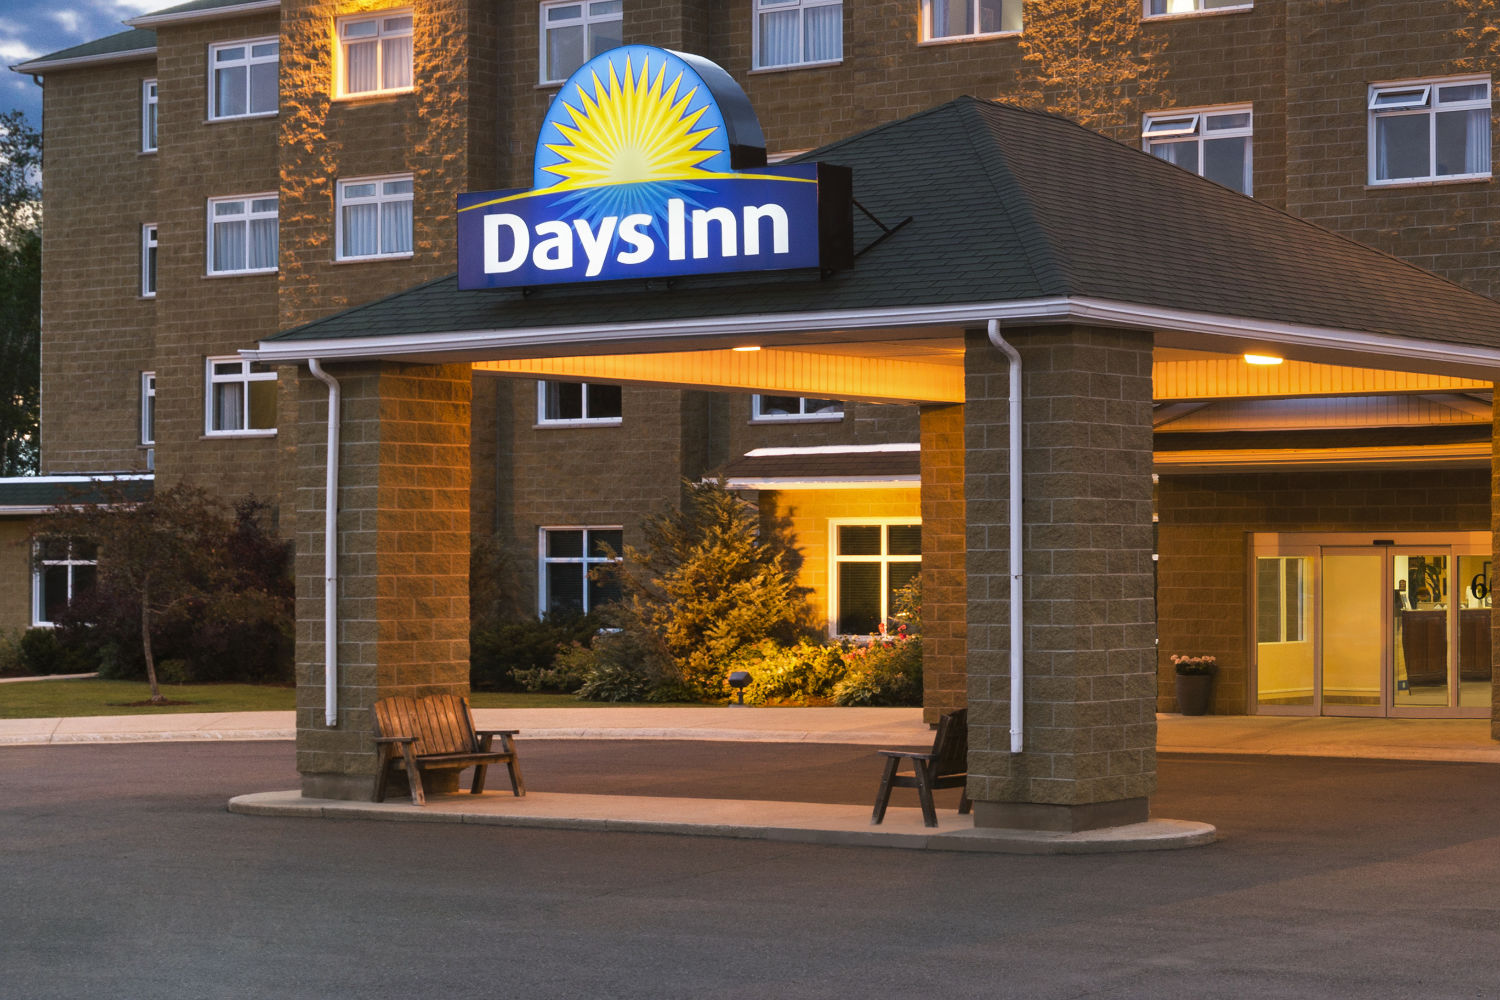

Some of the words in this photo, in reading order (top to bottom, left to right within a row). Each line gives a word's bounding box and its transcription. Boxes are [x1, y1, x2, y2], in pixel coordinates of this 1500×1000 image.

[483, 213, 655, 277] Days
[668, 198, 789, 261] Inn
[1471, 573, 1492, 600] 6
